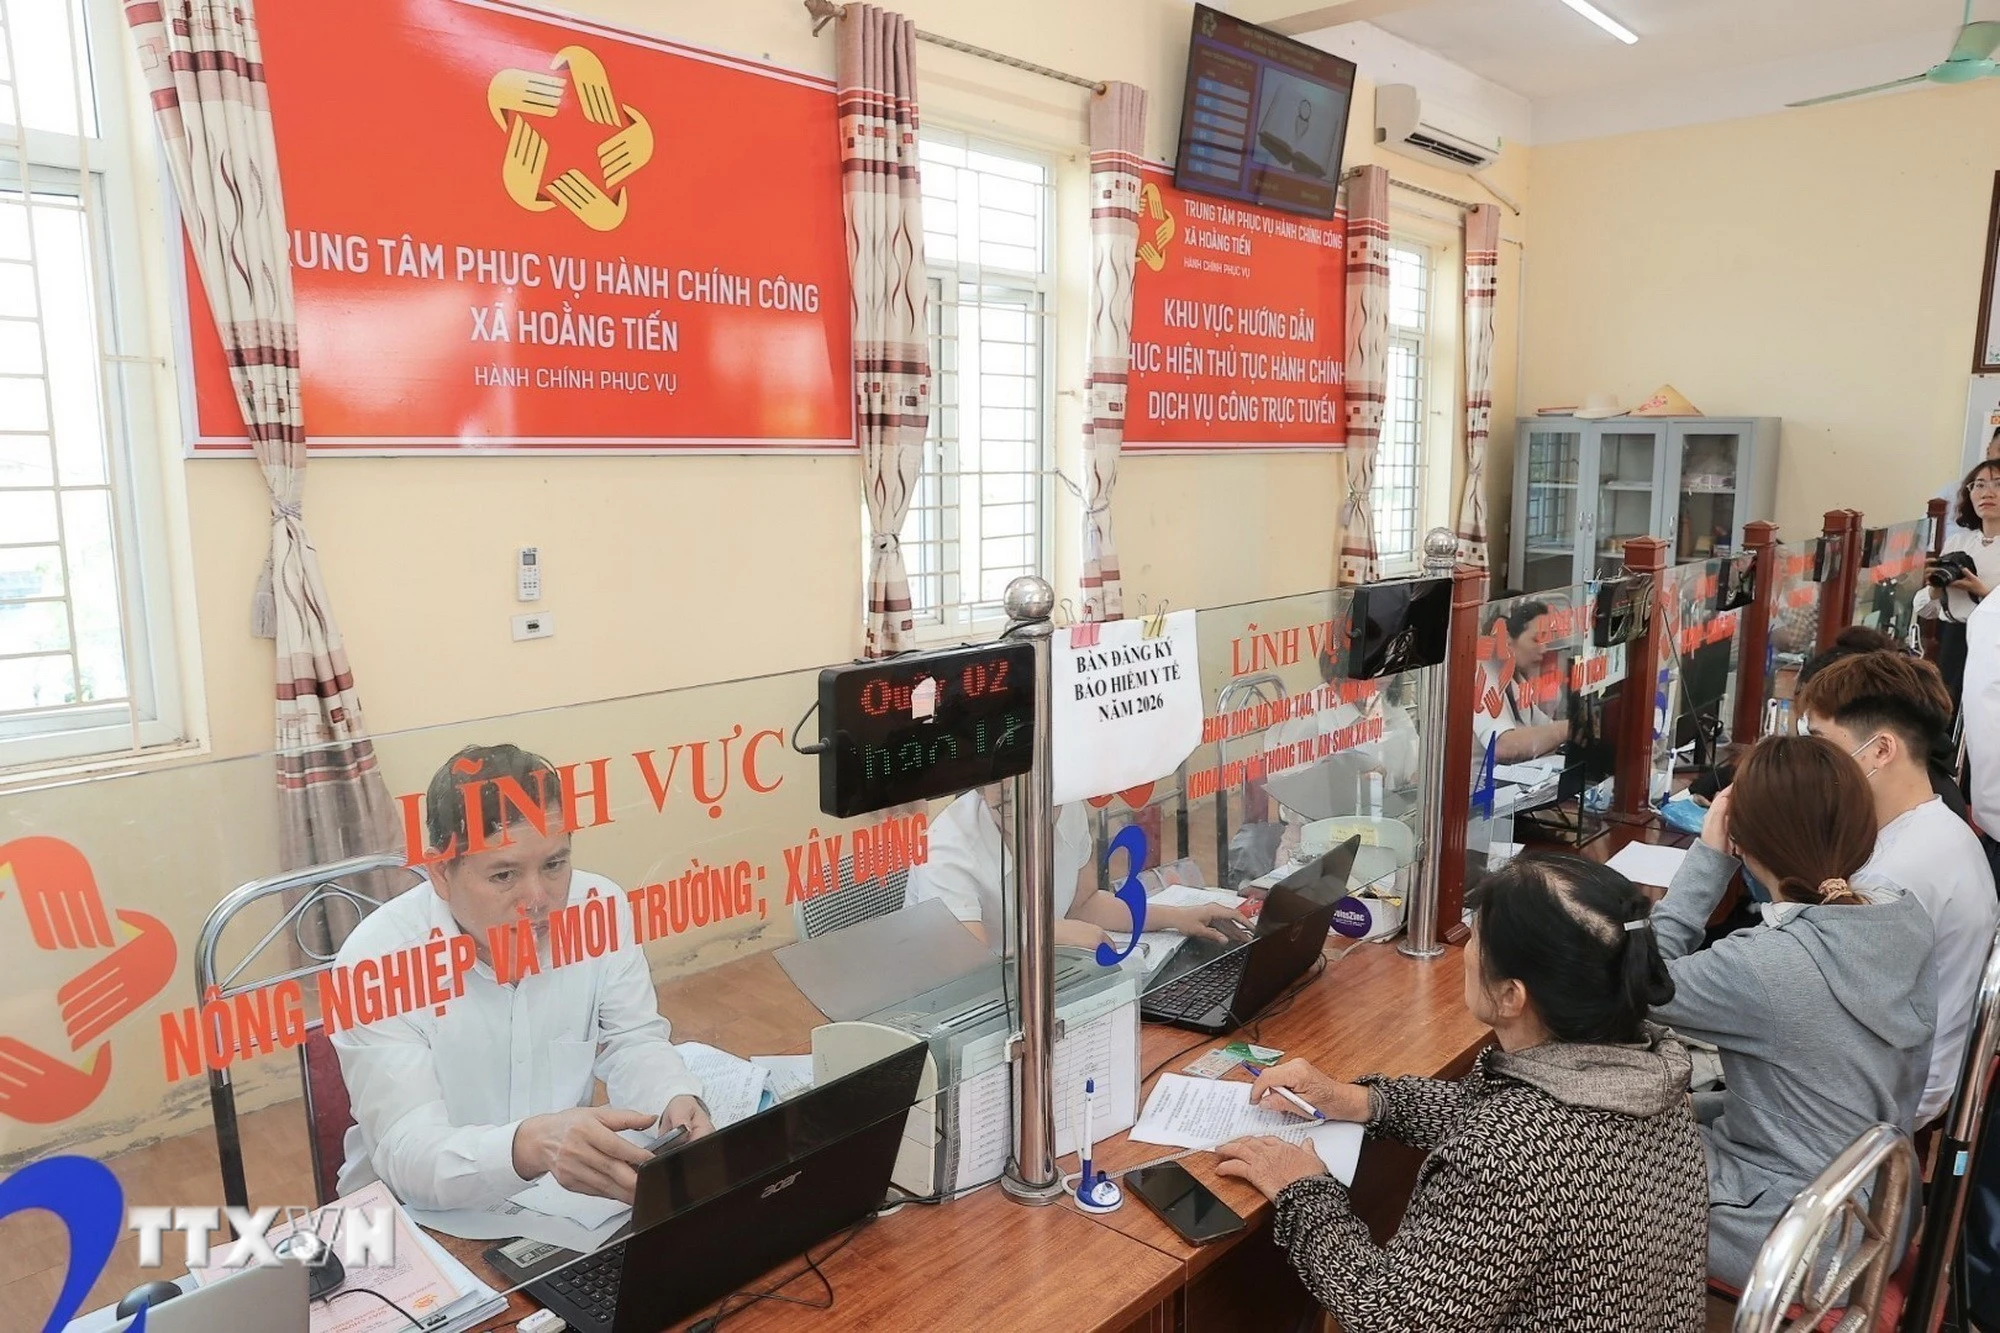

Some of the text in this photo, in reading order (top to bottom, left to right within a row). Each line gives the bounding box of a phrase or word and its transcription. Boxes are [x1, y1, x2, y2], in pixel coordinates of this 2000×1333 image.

[1184, 199, 1216, 222] TRUNG
[1217, 204, 1236, 226] TÂM
[1237, 210, 1261, 234] PHỤC
[1262, 216, 1274, 238] VỤ
[1184, 225, 1197, 247] XÃ
[1231, 233, 1252, 257] TIẾN
[377, 234, 445, 281] TÂM
[455, 246, 541, 293] PHỤC
[548, 256, 586, 300] VỤ
[596, 253, 670, 301] HÀNH
[677, 264, 752, 308] CHÍNH
[758, 276, 820, 315] CÔNG
[470, 298, 680, 353] XÃ HOẰNG TIẾN
[1164, 298, 1316, 343] KHU VỰC HƯỚNG DẪN
[474, 363, 678, 398] HÀNH CHÍNH PHỤC VỤ
[1166, 340, 1204, 381] HIỆN
[1207, 344, 1237, 378] THỦ
[1240, 351, 1268, 385] TỤC
[1271, 350, 1306, 383] HÀNH
[1148, 390, 1336, 429] DỊCH VỤ CÔNG TRỰC TUYẾN
[1076, 635, 1174, 674] BÀN ĐĂNG KÝ
[1231, 622, 1300, 677] LĨNH
[962, 658, 1010, 698] 02
[1074, 659, 1182, 701] BẢO HIỂM Y TẾ
[1098, 692, 1164, 722] NĂM 2026
[394, 724, 786, 869] LĨNH VỰC
[1473, 729, 1497, 821] 4
[1096, 824, 1148, 968] 3
[159, 979, 307, 1083] NÔNG
[317, 926, 477, 1036] NGHIỆP
[485, 905, 541, 986] VÀ
[548, 886, 620, 970] MÔI
[782, 827, 844, 906] XÂY
[853, 812, 929, 887] DỰNG
[761, 1170, 802, 1198] acer
[0, 1156, 148, 1333] 2
